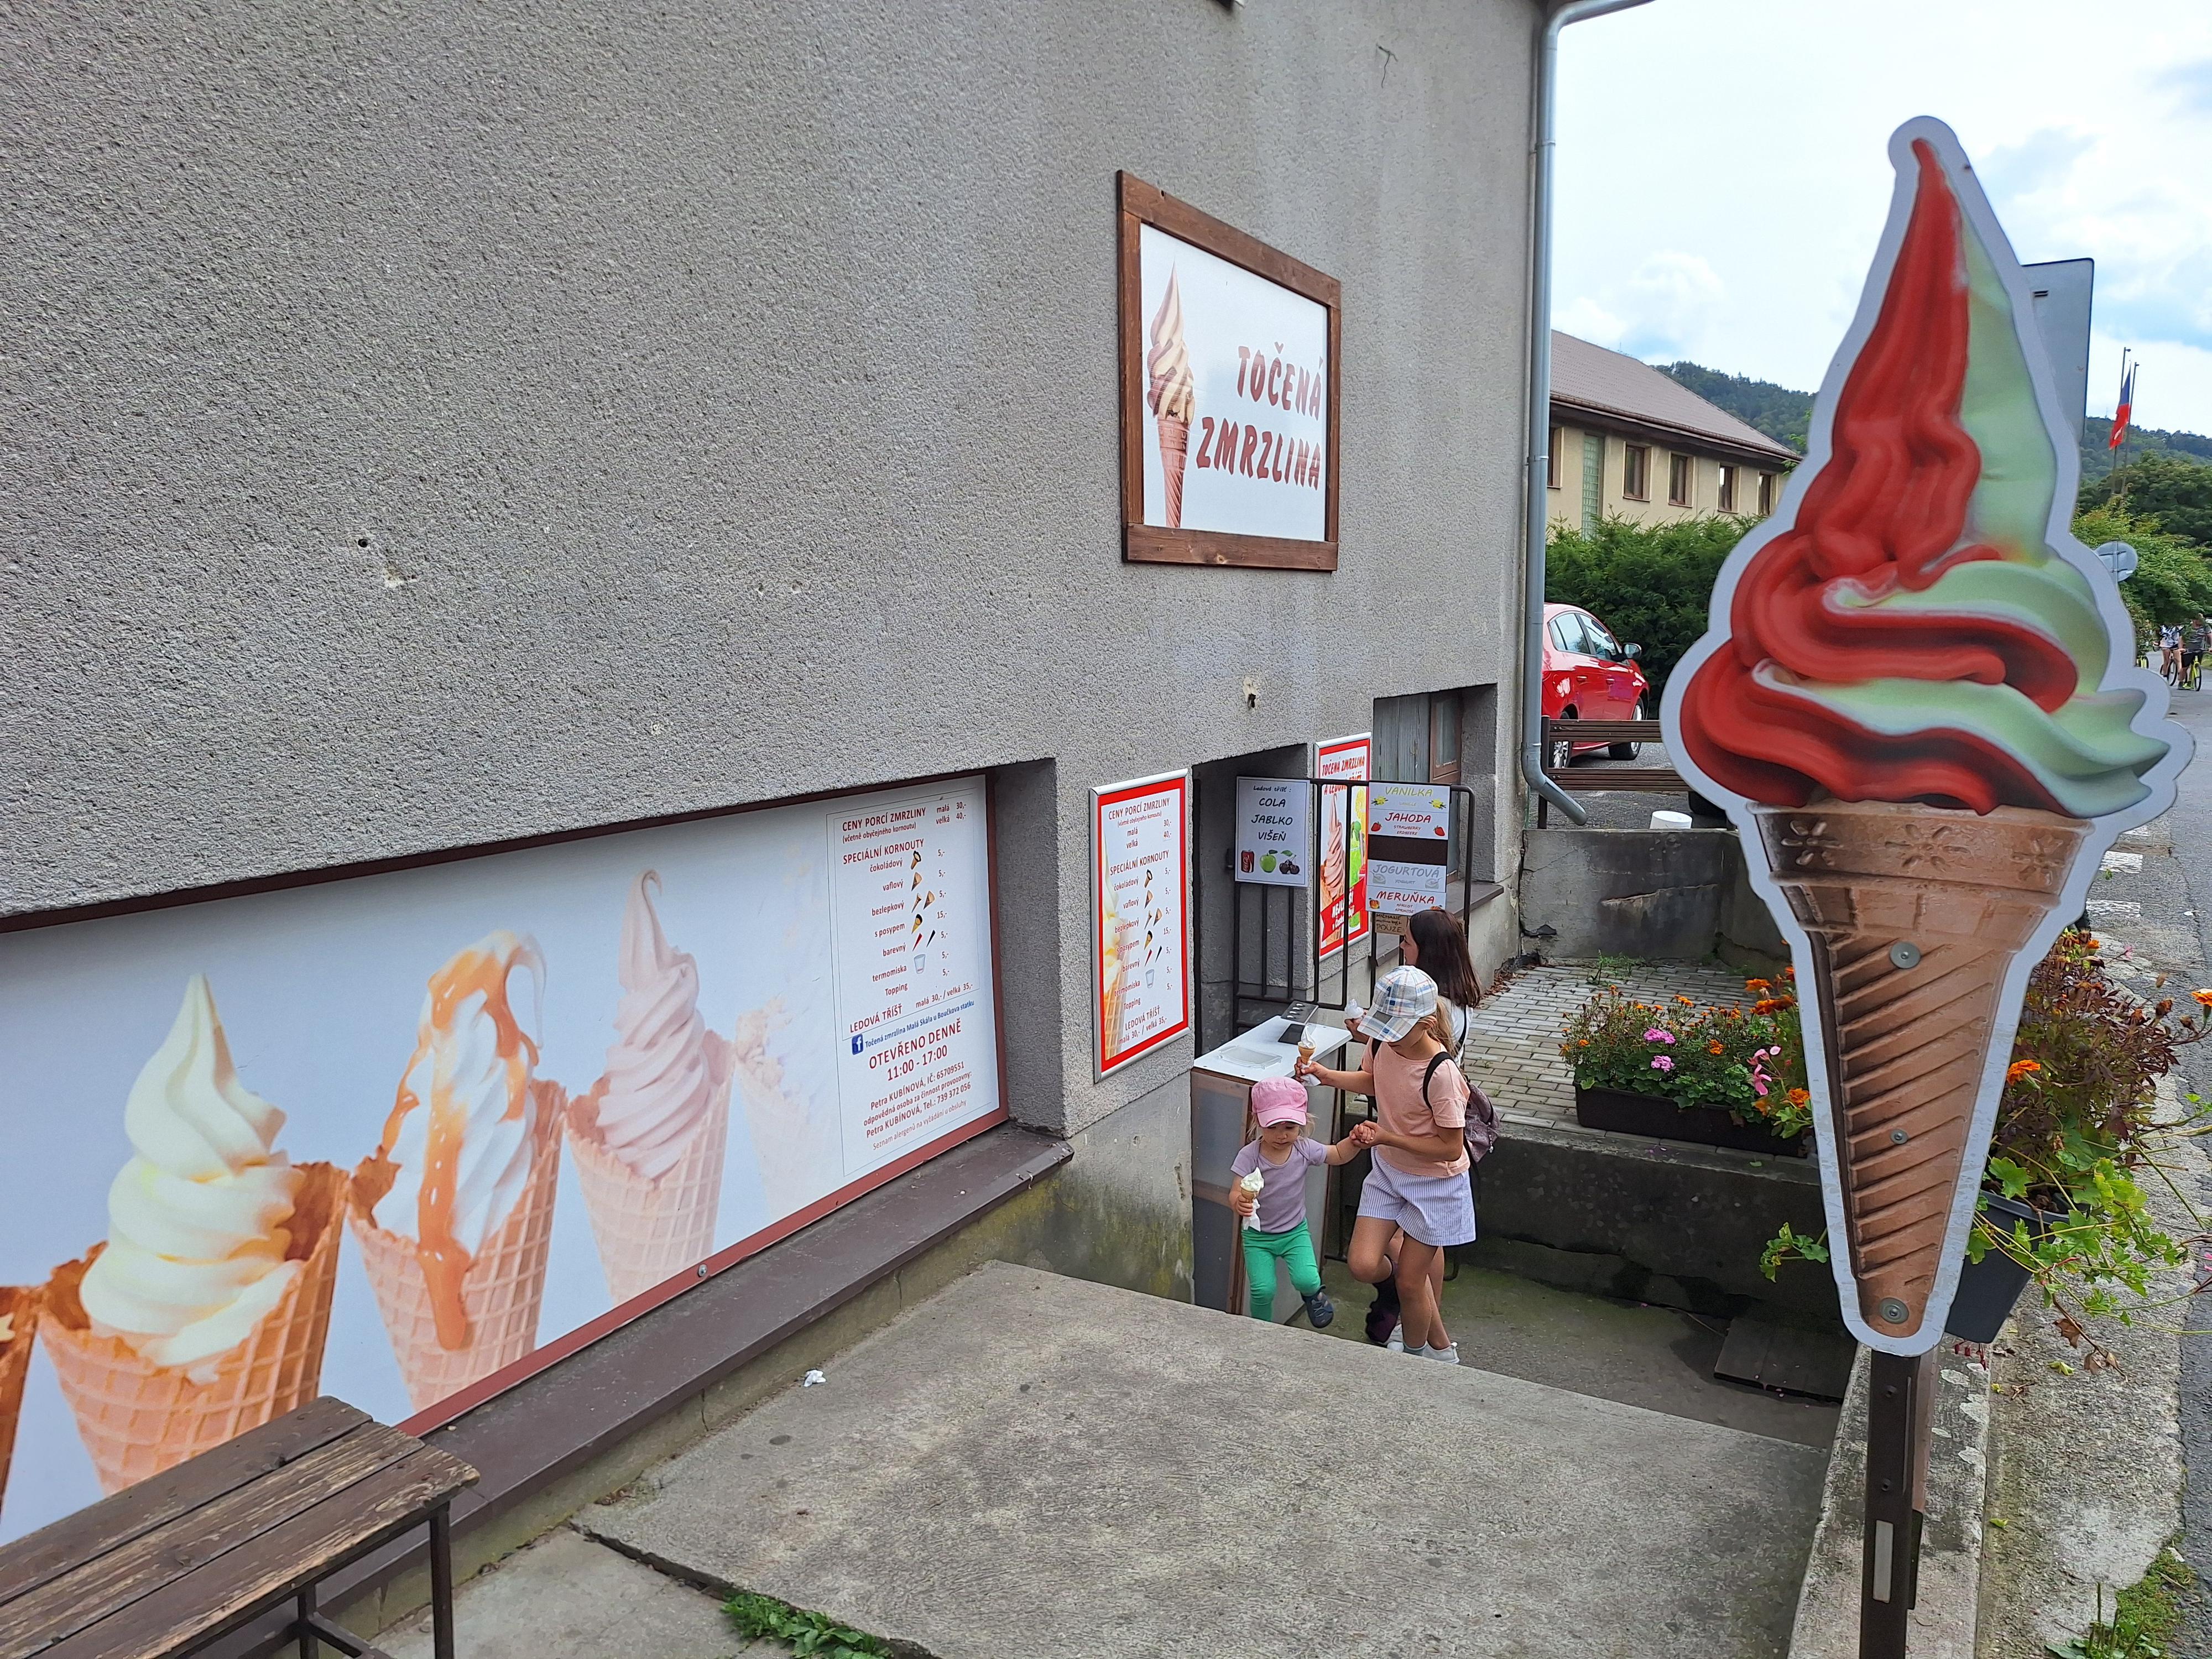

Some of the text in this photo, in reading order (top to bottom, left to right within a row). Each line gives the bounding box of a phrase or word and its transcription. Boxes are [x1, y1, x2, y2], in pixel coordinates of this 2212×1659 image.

[1237, 341, 1324, 420] TOČENÁ
[1196, 416, 1322, 491] ZMRZLINA
[1322, 755, 1365, 776] TOČENÁ ZMRZLINA
[1385, 786, 1432, 796] VANILKA
[937, 802, 966, 813] malá 30,-
[1109, 798, 1170, 820] CENY PORCÍ ZMRZLINY
[1259, 798, 1286, 807] COLA
[843, 807, 926, 831] CENY PORCÍ ZMRZLINY
[936, 815, 950, 825] velká
[1251, 815, 1293, 826] JABLKO
[1385, 812, 1431, 823] JAHODA
[843, 822, 916, 844] (včetně obyčejného kornoutu)
[1127, 826, 1138, 837] malá
[1258, 830, 1286, 841] VIŠEŇ
[843, 838, 924, 865] SPECIÁLNÍ KORNOUTY
[1126, 838, 1138, 849] velká
[870, 858, 902, 872] čokoládový
[1110, 849, 1169, 877] SPECIÁLNÍ KORNOUTY
[1373, 864, 1440, 878] JOGURTOVÁ
[883, 879, 904, 891] vaflový
[1114, 877, 1139, 891] čokoládový
[1123, 897, 1139, 910] vaflový
[1376, 891, 1434, 904] MERUŇKA
[872, 900, 904, 916] bezlepkový
[879, 924, 905, 938] posypem
[937, 911, 947, 920] 15,-
[1115, 918, 1139, 934] bezlepkový
[1376, 924, 1402, 932] POUZE
[883, 942, 906, 957] barevný
[872, 965, 907, 982] termomiska
[1122, 959, 1140, 972] barevný
[885, 983, 908, 996] Topping
[916, 999, 929, 1008] malá
[932, 992, 942, 1002] 30,-
[947, 987, 961, 998] velká
[963, 982, 973, 992] 35,-
[1114, 980, 1140, 997] termomiska
[1124, 997, 1141, 1010] Topping
[850, 1003, 902, 1033] LEDOVÁ TŘÍŠŤ
[865, 1036, 883, 1048] Točená
[885, 1027, 906, 1040] zmrzlina
[907, 1020, 919, 1031] Malá
[920, 1016, 932, 1026] Skála
[937, 1006, 959, 1020] Boučkova
[960, 1000, 974, 1010] statku
[1125, 1005, 1160, 1031] LEDOVÁ TŘÍŠŤ
[1119, 1034, 1130, 1045] malá
[1131, 1029, 1140, 1038] 30,-
[1146, 1021, 1157, 1031] velká
[1159, 1016, 1167, 1025] 35,-
[869, 1018, 962, 1070] OTEVŘENO DENNĚ
[888, 1059, 914, 1081] 11:00
[922, 1045, 947, 1066] 17:00
[871, 1061, 964, 1110] Petra KUBÍNOVÁ, IČ: 65709551
[864, 1105, 895, 1126] odpovědná
[897, 1099, 912, 1110] osoba
[921, 1086, 940, 1099] činnost
[941, 1071, 972, 1091] provozovny:
[867, 1082, 971, 1138] Petra KUBÍNOVÁ, Tel.: 739 372 056
[873, 1136, 893, 1151] Seznam
[894, 1124, 915, 1140] alergenů
[924, 1109, 944, 1125] vyžádání
[949, 1099, 967, 1113] obsluhy
